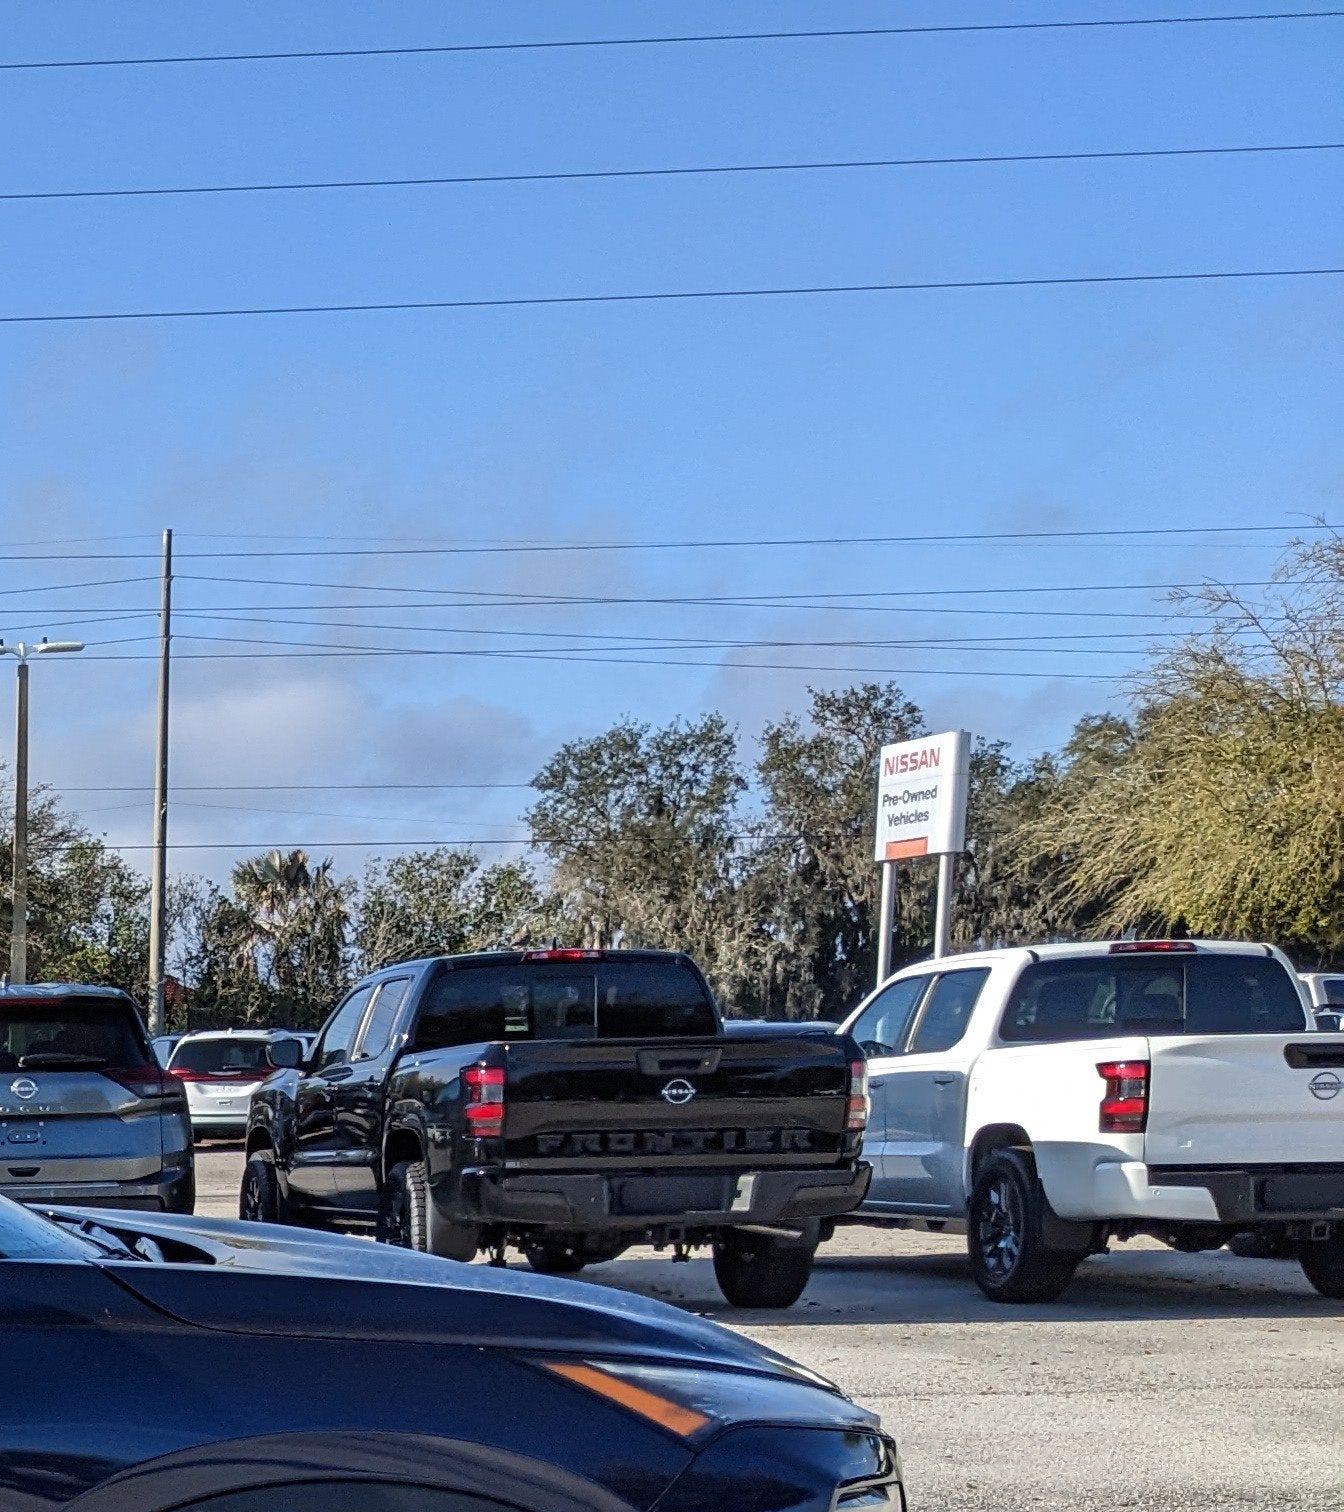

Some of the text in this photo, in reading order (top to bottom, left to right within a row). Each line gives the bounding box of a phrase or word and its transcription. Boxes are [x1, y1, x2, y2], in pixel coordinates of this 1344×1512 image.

[884, 747, 940, 777] NISSAN
[882, 785, 938, 807] Pre-Owned
[887, 810, 930, 827] Vehicles
[537, 1127, 812, 1153] FRONTIER
